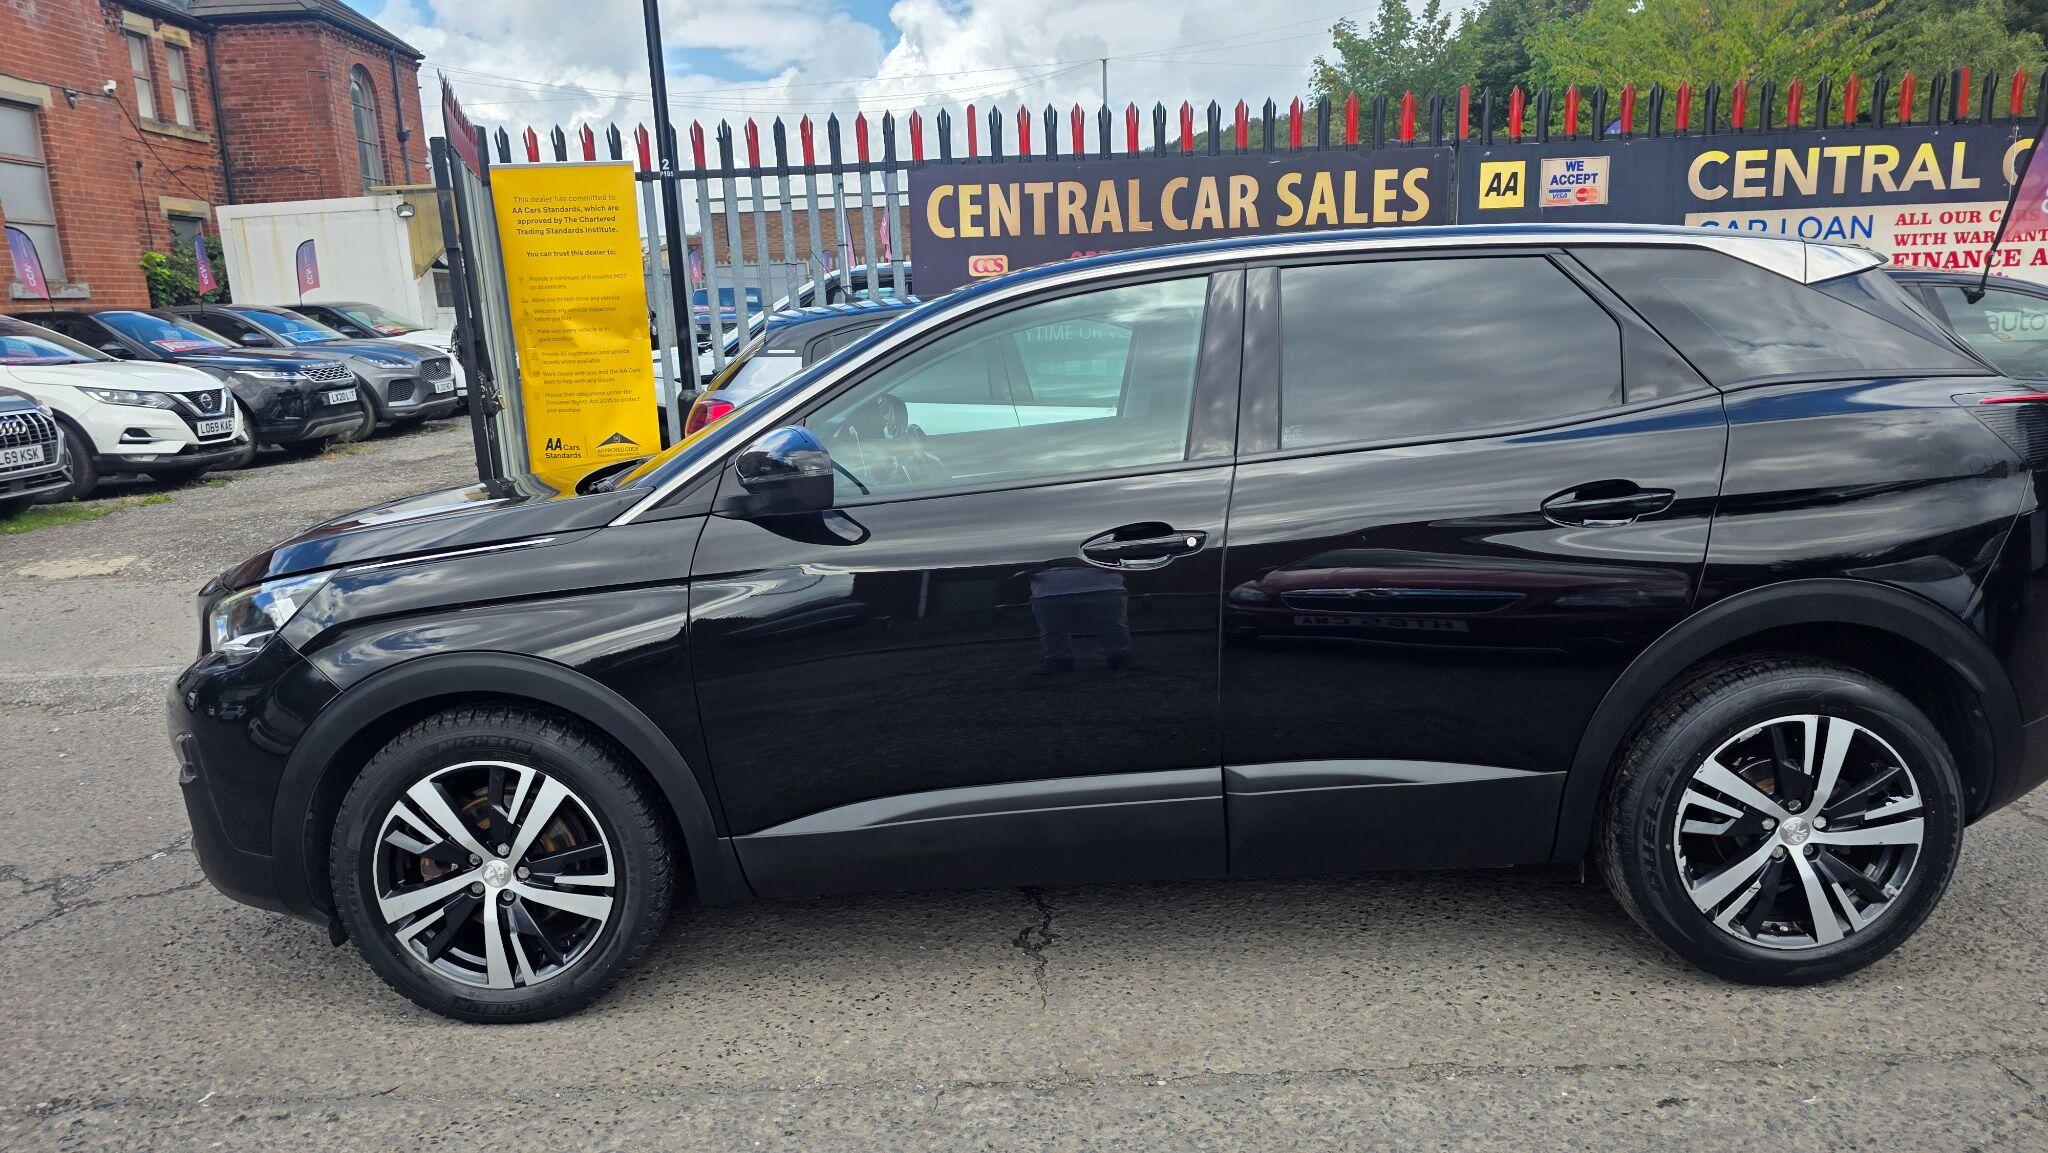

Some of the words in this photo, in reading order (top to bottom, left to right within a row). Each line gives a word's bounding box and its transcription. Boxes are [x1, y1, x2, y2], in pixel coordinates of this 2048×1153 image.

[661, 158, 670, 170] 2
[1565, 161, 1584, 172] WE
[1687, 141, 1981, 201] CENTRAL
[1484, 171, 1519, 197] AA
[1550, 173, 1599, 186] ACCEPT
[568, 194, 608, 202] committed
[926, 178, 1153, 239] CENTRAL
[1160, 173, 1262, 230] CAR
[1276, 167, 1430, 227] SALES
[517, 217, 552, 225] approved
[1895, 211, 1932, 226] ALL
[1942, 210, 1983, 225] OUR
[516, 227, 545, 235] Trading
[1894, 232, 1944, 247] WITH
[1953, 229, 2048, 246] WARANT
[220, 419, 233, 431] KAE
[545, 437, 562, 451] AA
[20, 448, 40, 461] KSK
